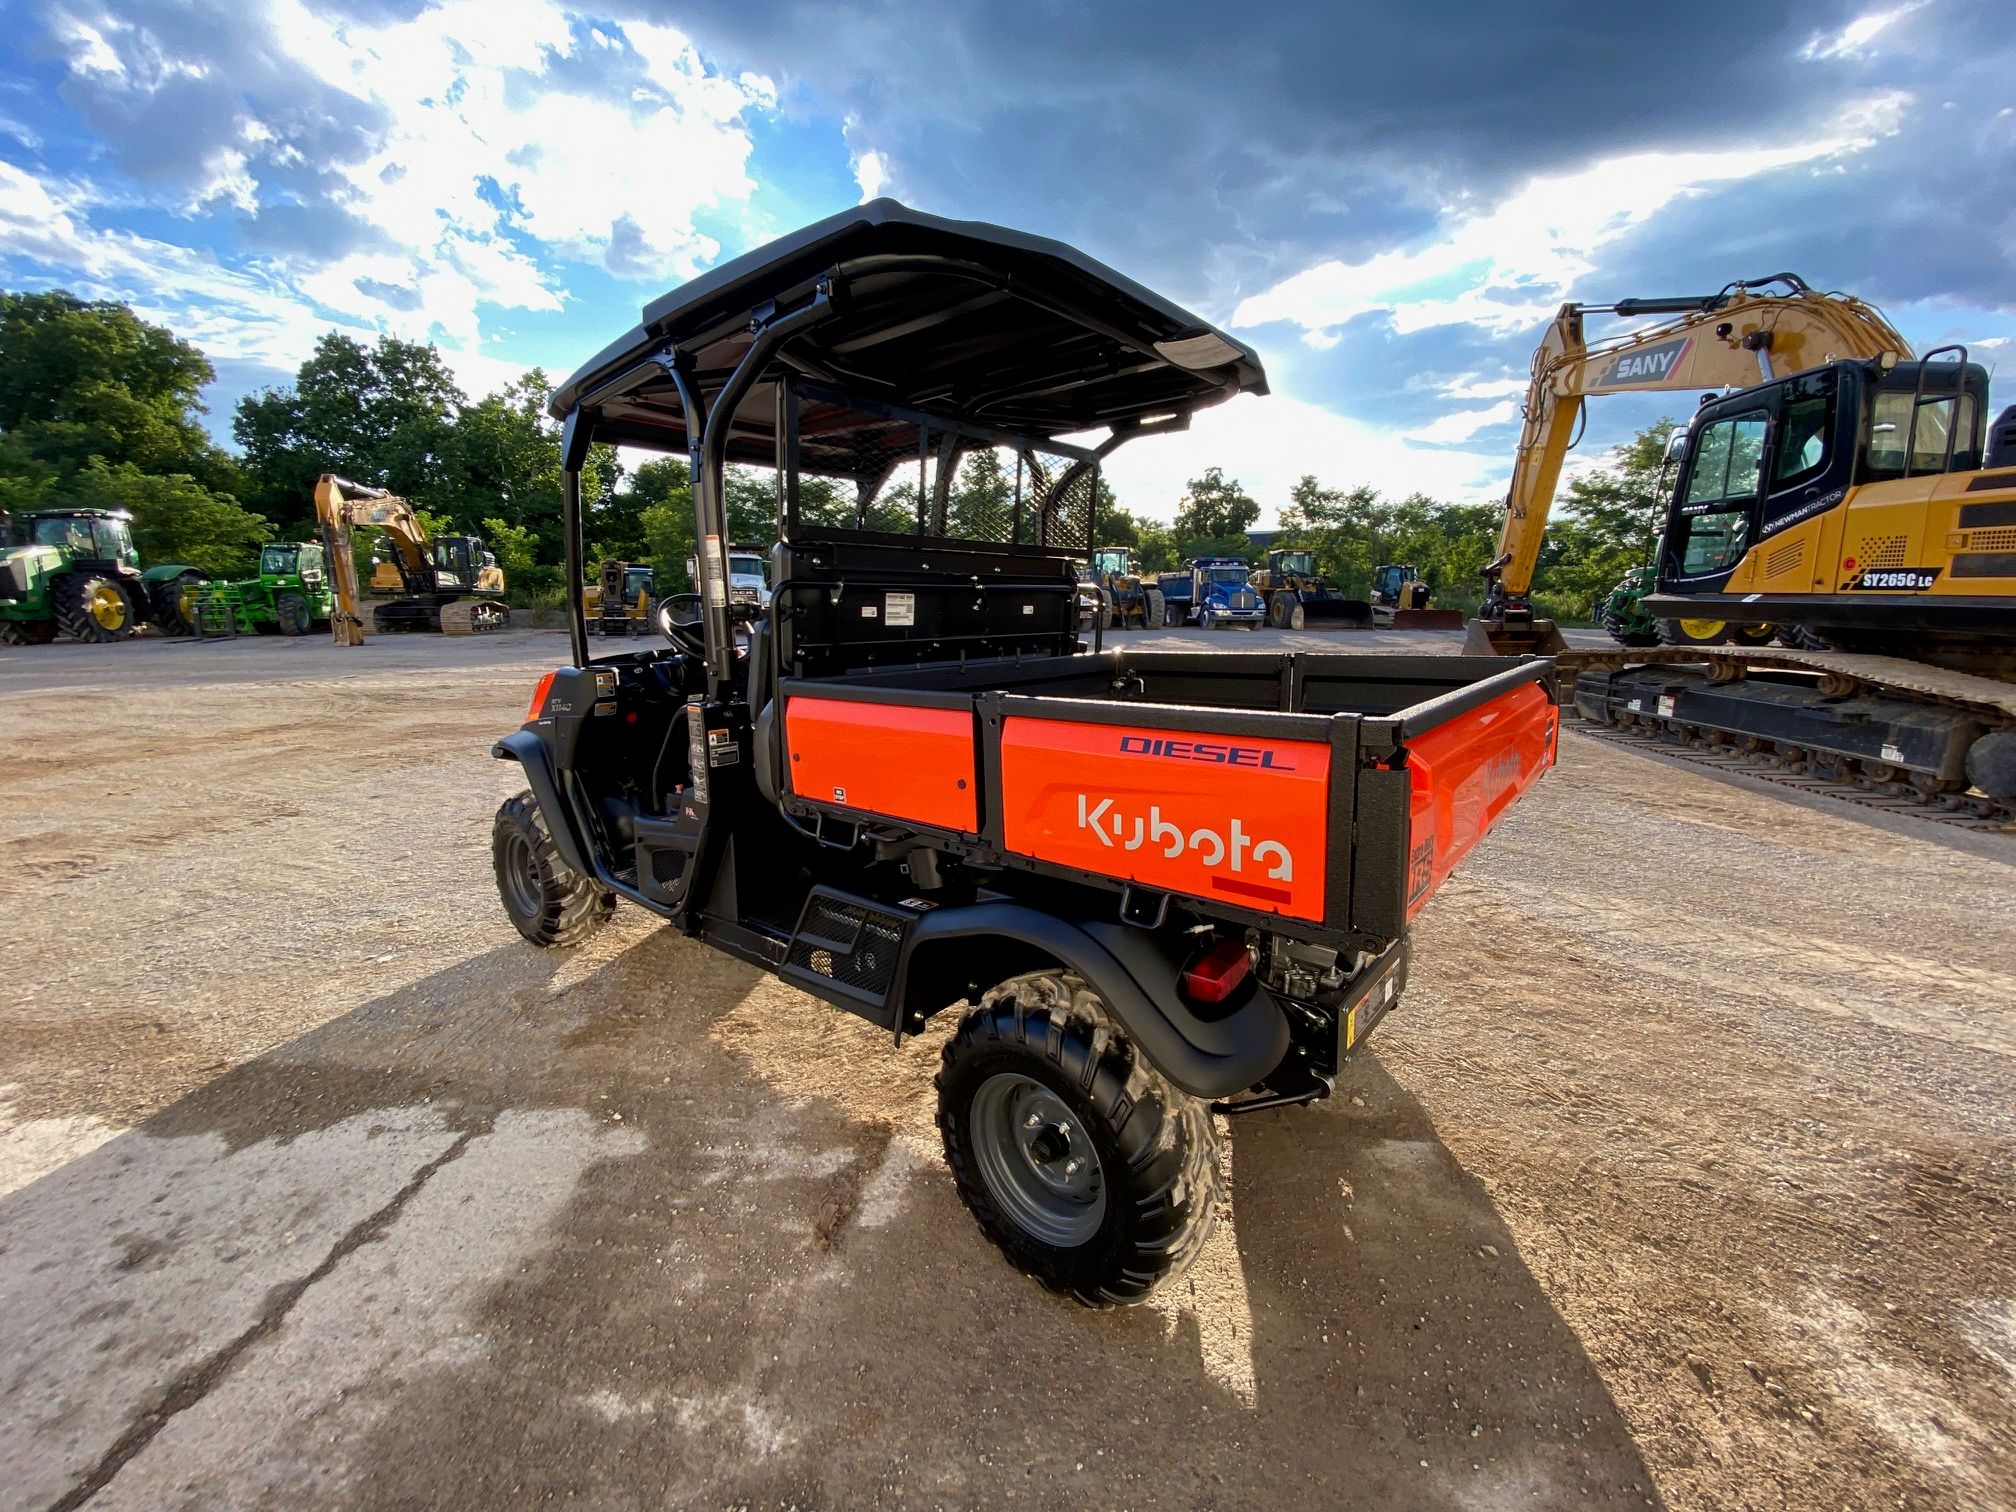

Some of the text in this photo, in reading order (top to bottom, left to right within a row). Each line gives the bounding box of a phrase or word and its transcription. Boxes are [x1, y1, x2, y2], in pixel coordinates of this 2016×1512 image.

[1616, 350, 1675, 379] SANY
[1862, 573, 1933, 587] SY265C LC
[1120, 736, 1296, 771] DIESEL
[1078, 794, 1293, 883] Kubota
